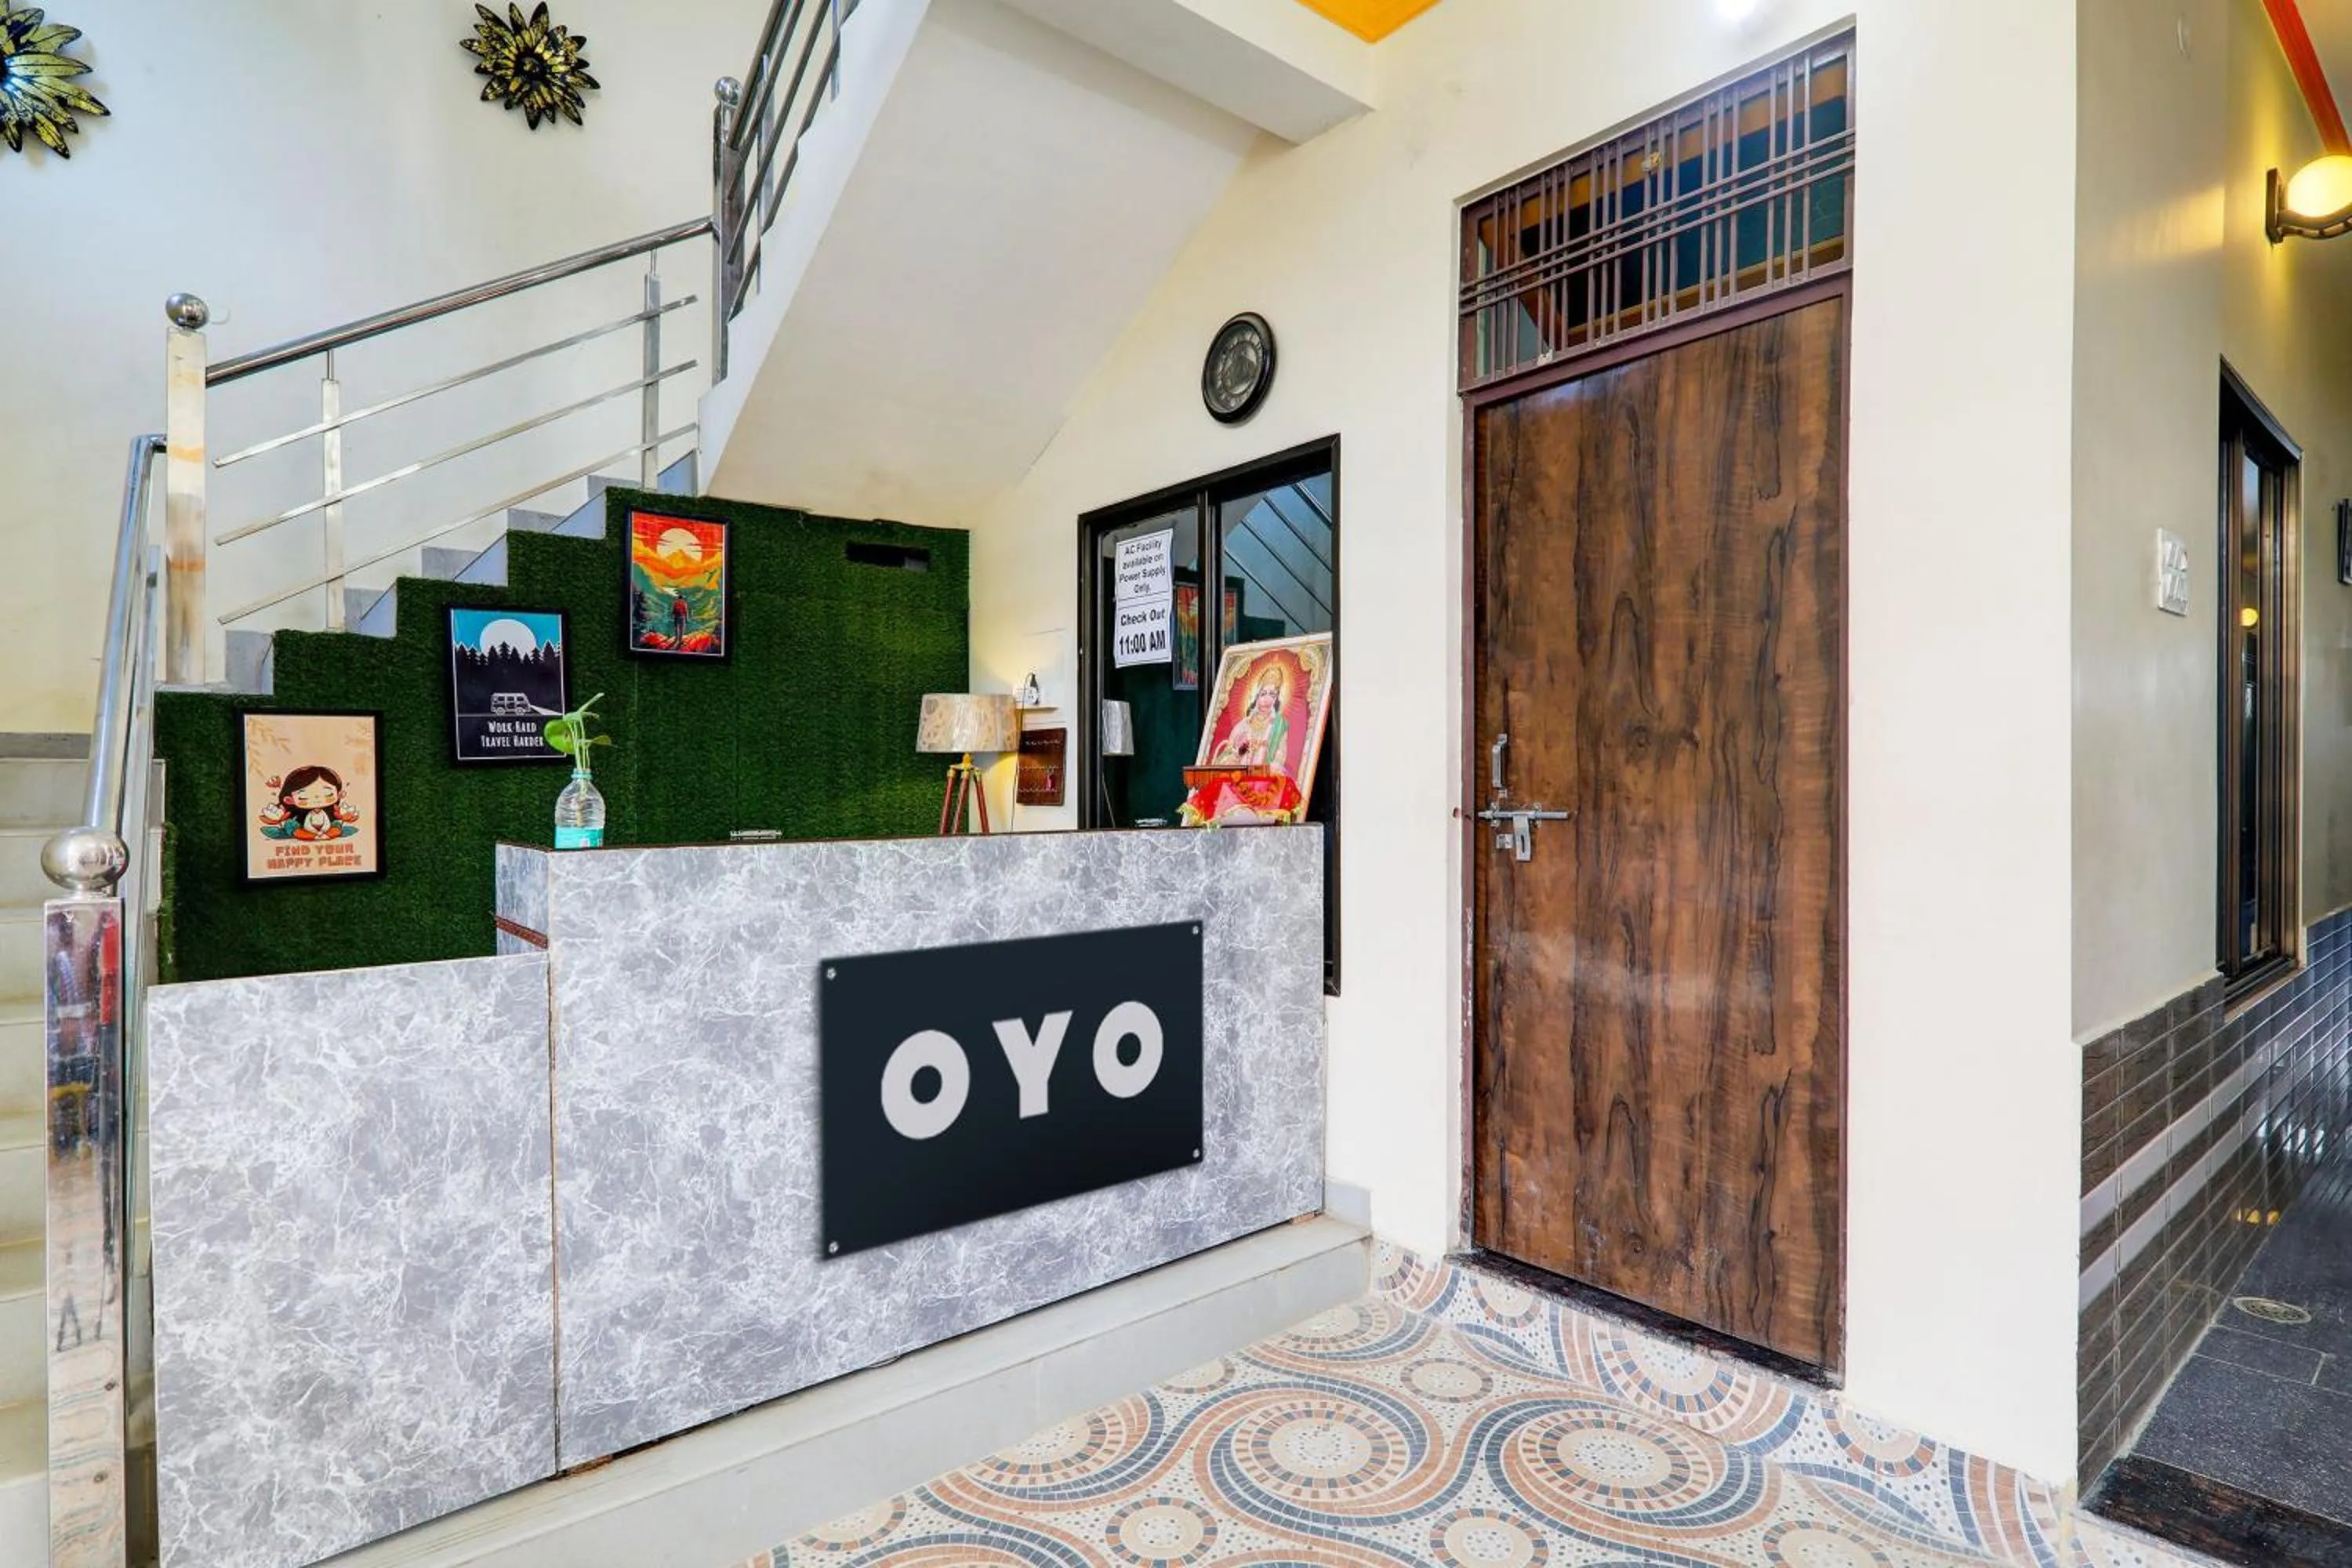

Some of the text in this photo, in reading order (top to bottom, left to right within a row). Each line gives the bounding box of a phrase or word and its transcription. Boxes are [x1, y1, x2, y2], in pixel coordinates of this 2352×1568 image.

[1124, 539, 1163, 555] AC Facility
[1123, 554, 1164, 570] available on
[1119, 564, 1166, 583] Power Supply
[1120, 608, 1165, 626] Check Out
[1120, 630, 1166, 655] 11:00 AM
[488, 721, 537, 732] WORK HARD
[481, 735, 543, 747] TRAVEL HARDER
[275, 844, 354, 856] FIND YOUR
[267, 855, 361, 869] HAPPY PLACE
[881, 1000, 1164, 1140] OYO
